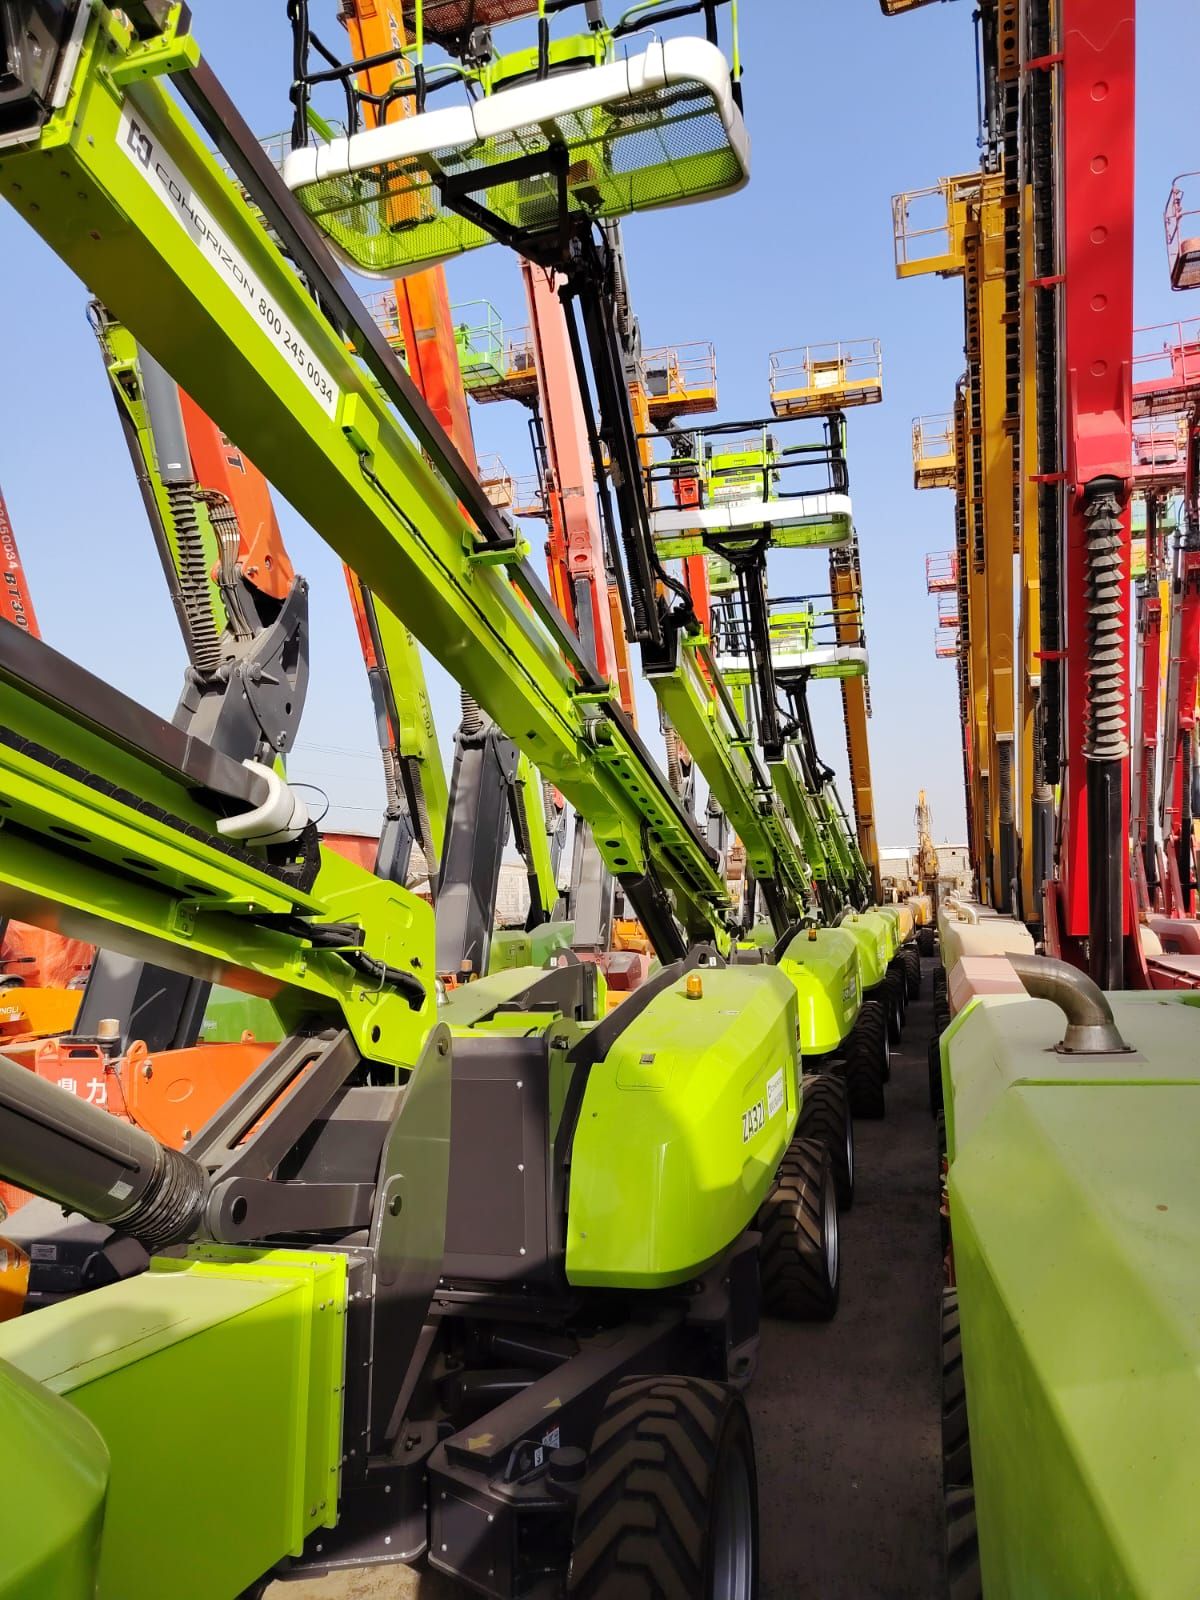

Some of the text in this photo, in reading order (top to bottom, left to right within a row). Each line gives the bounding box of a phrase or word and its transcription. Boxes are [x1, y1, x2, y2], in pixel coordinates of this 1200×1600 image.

[155, 163, 334, 405] COHORIZON 800 245 0034
[4, 571, 29, 632] BT30
